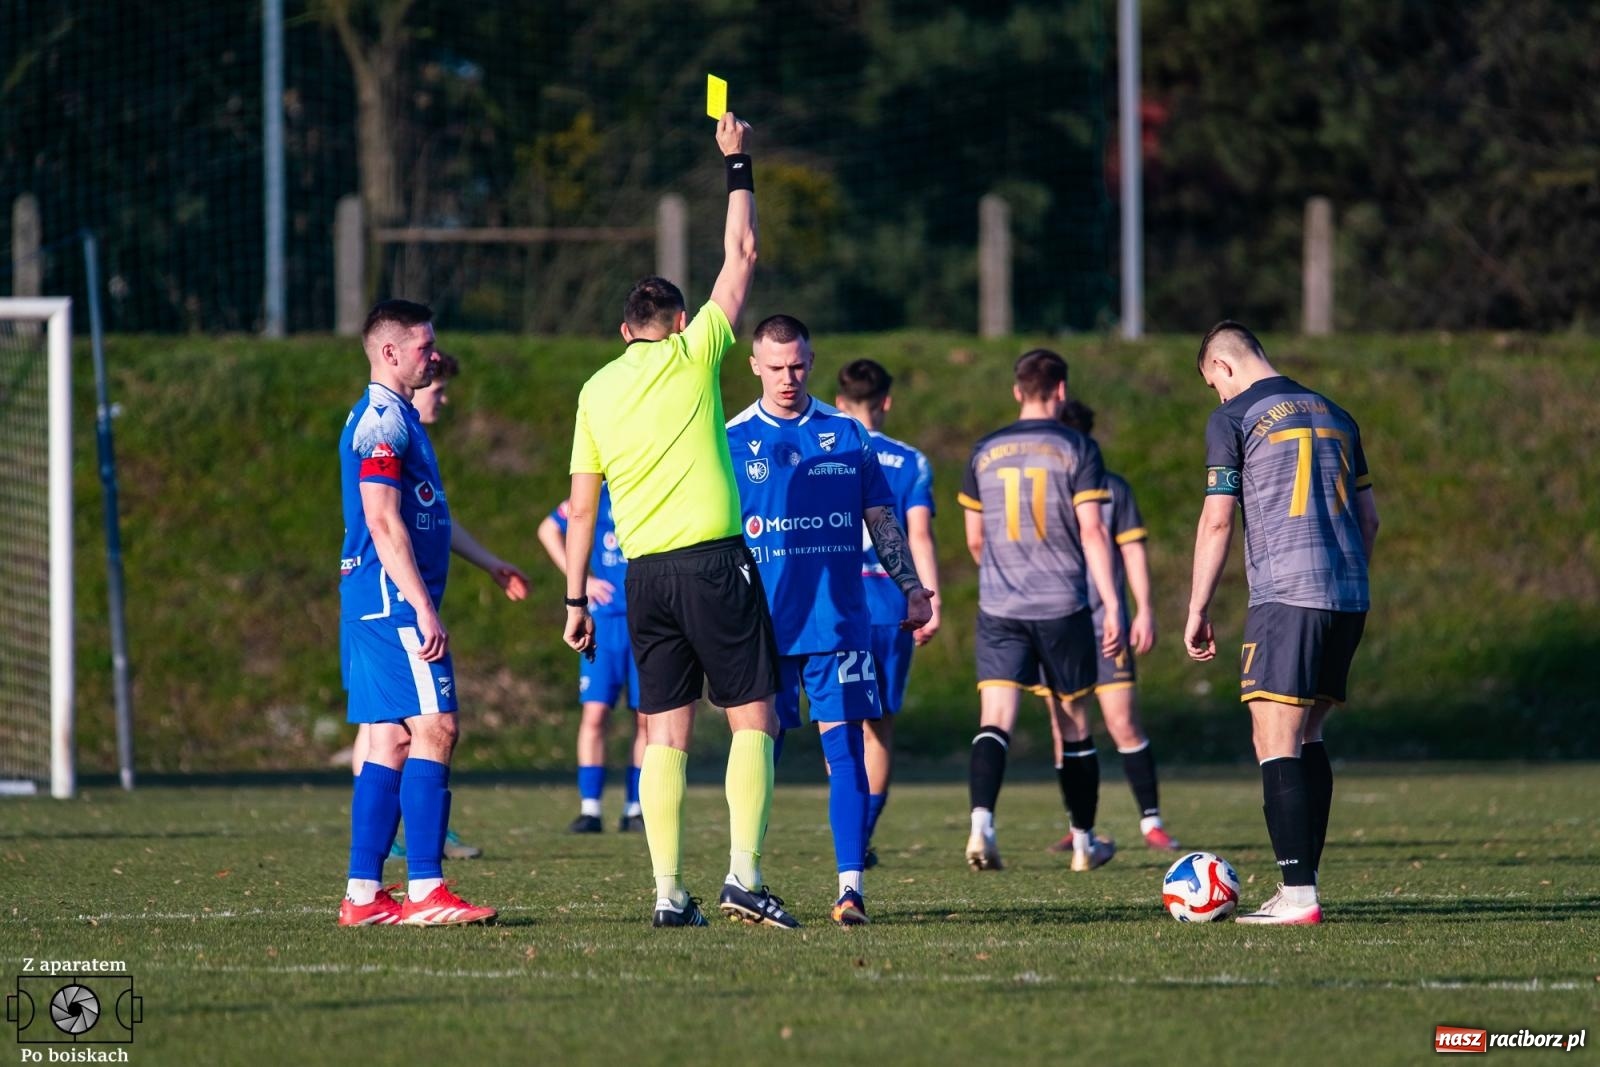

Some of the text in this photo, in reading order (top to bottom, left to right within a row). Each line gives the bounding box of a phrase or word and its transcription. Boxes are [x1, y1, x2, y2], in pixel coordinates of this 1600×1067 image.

[1267, 401, 1299, 421] RUCH
[808, 466, 856, 476] AGROTEAM
[1268, 427, 1350, 516] 77
[996, 466, 1048, 541] 11
[766, 512, 853, 533] Marco Oil
[772, 547, 786, 557] MB
[836, 650, 876, 684] 22
